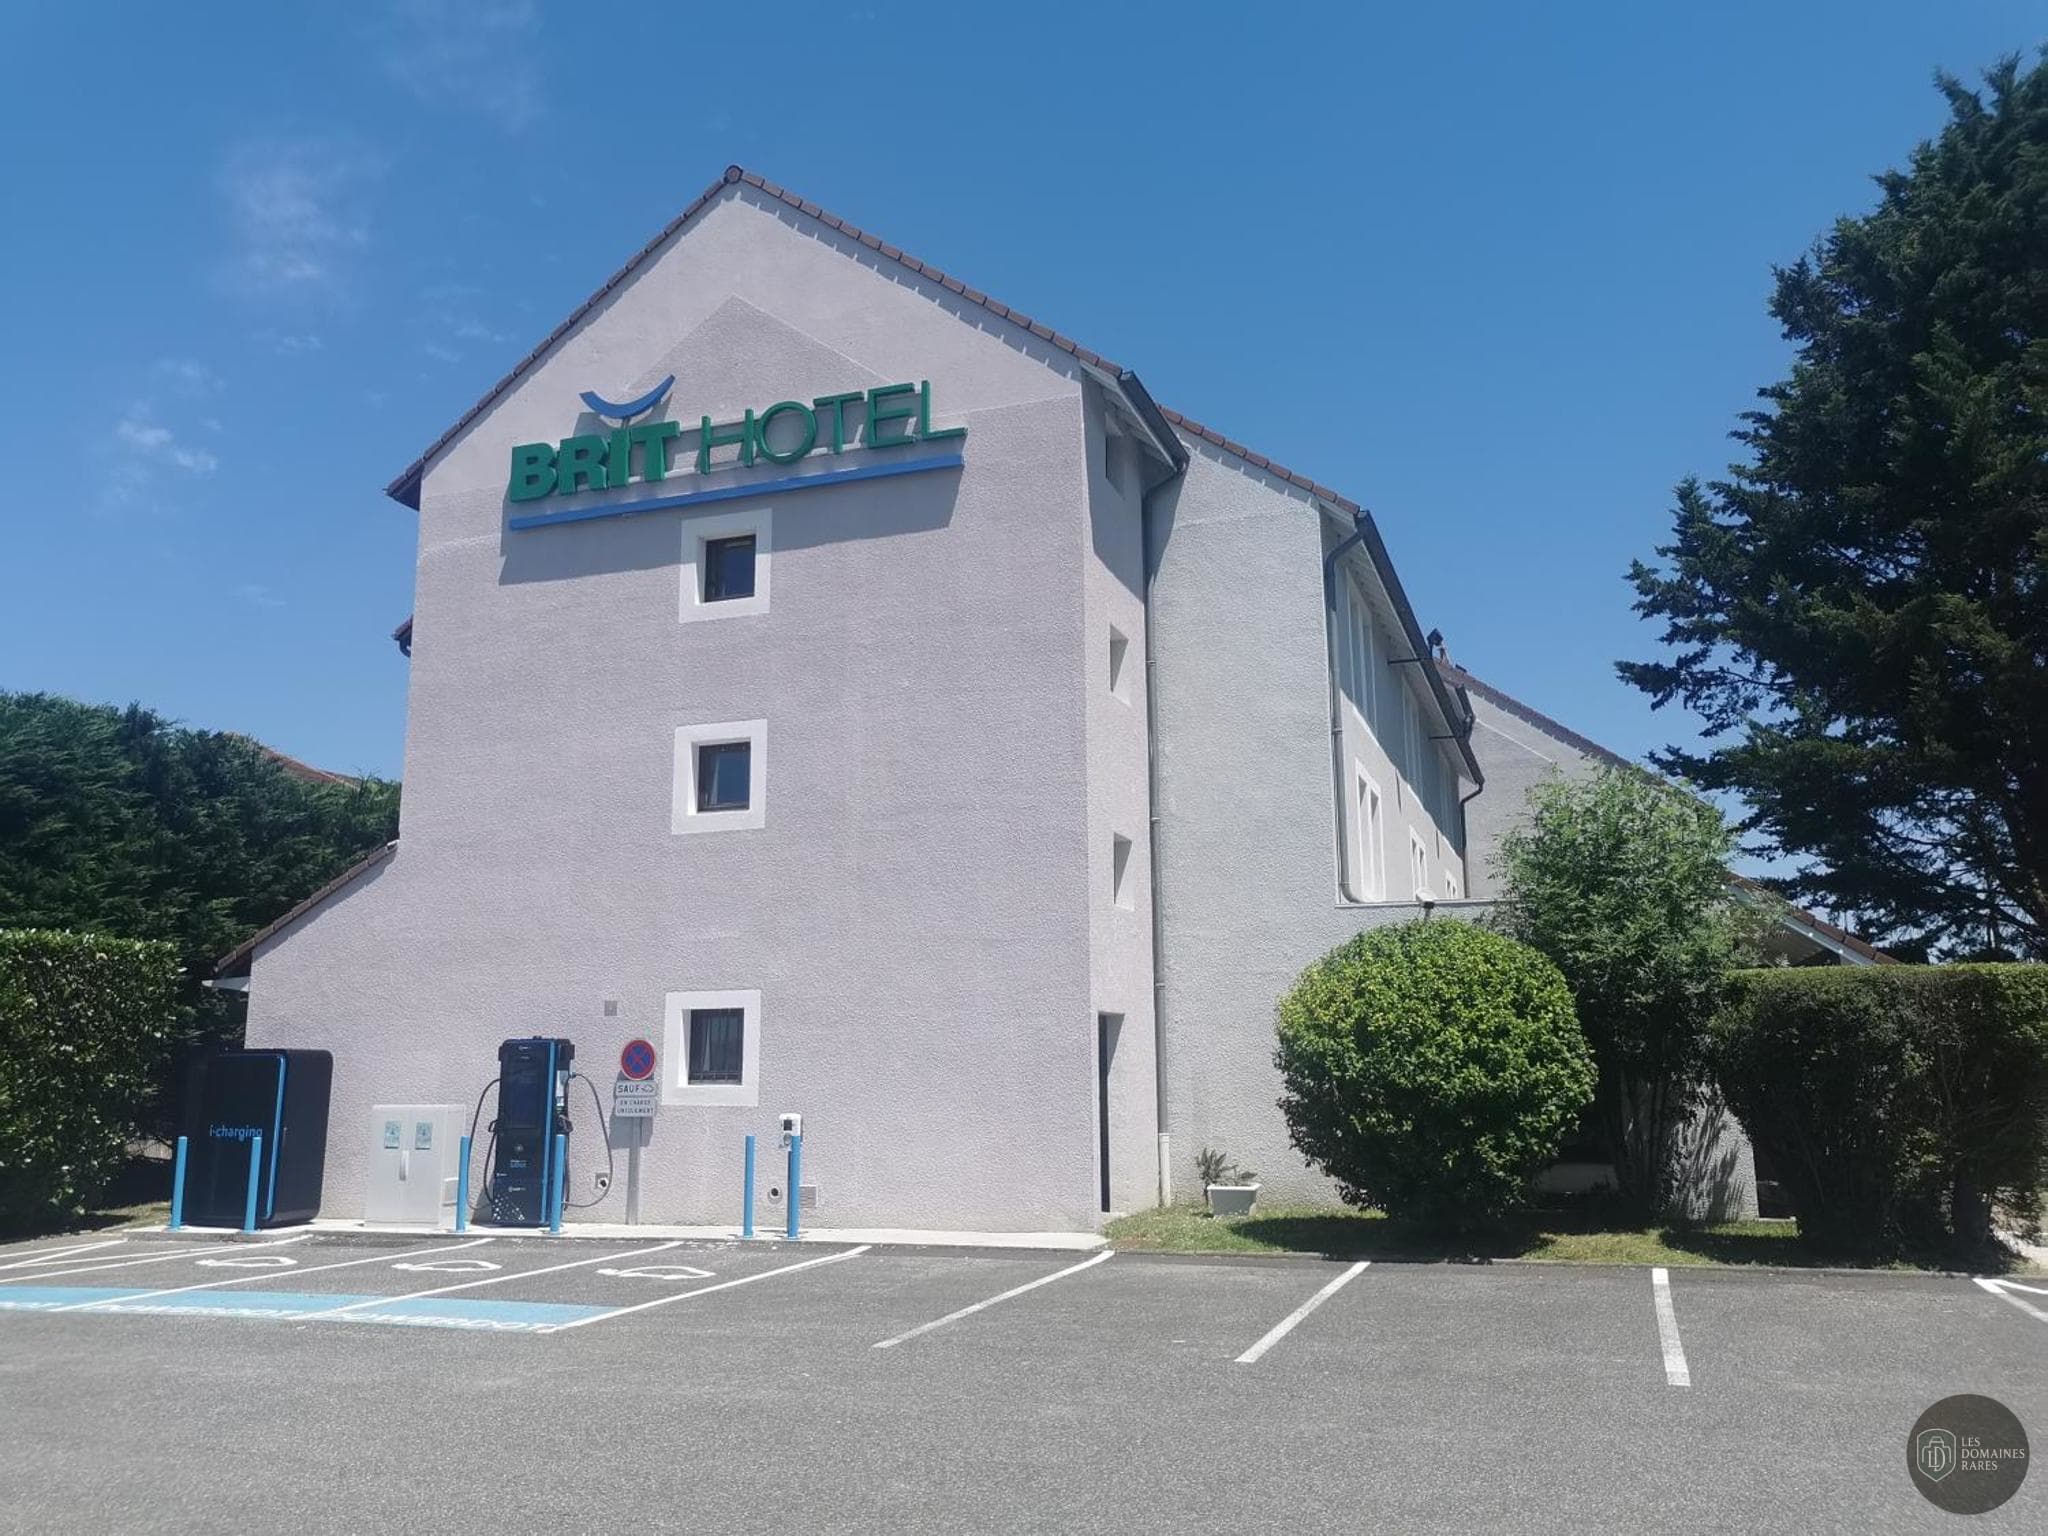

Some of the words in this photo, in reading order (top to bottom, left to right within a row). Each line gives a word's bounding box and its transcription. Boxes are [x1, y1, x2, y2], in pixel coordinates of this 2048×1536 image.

[511, 420, 680, 502] BRIT
[700, 380, 968, 474] HOTEL
[618, 1084, 639, 1094] SAUF
